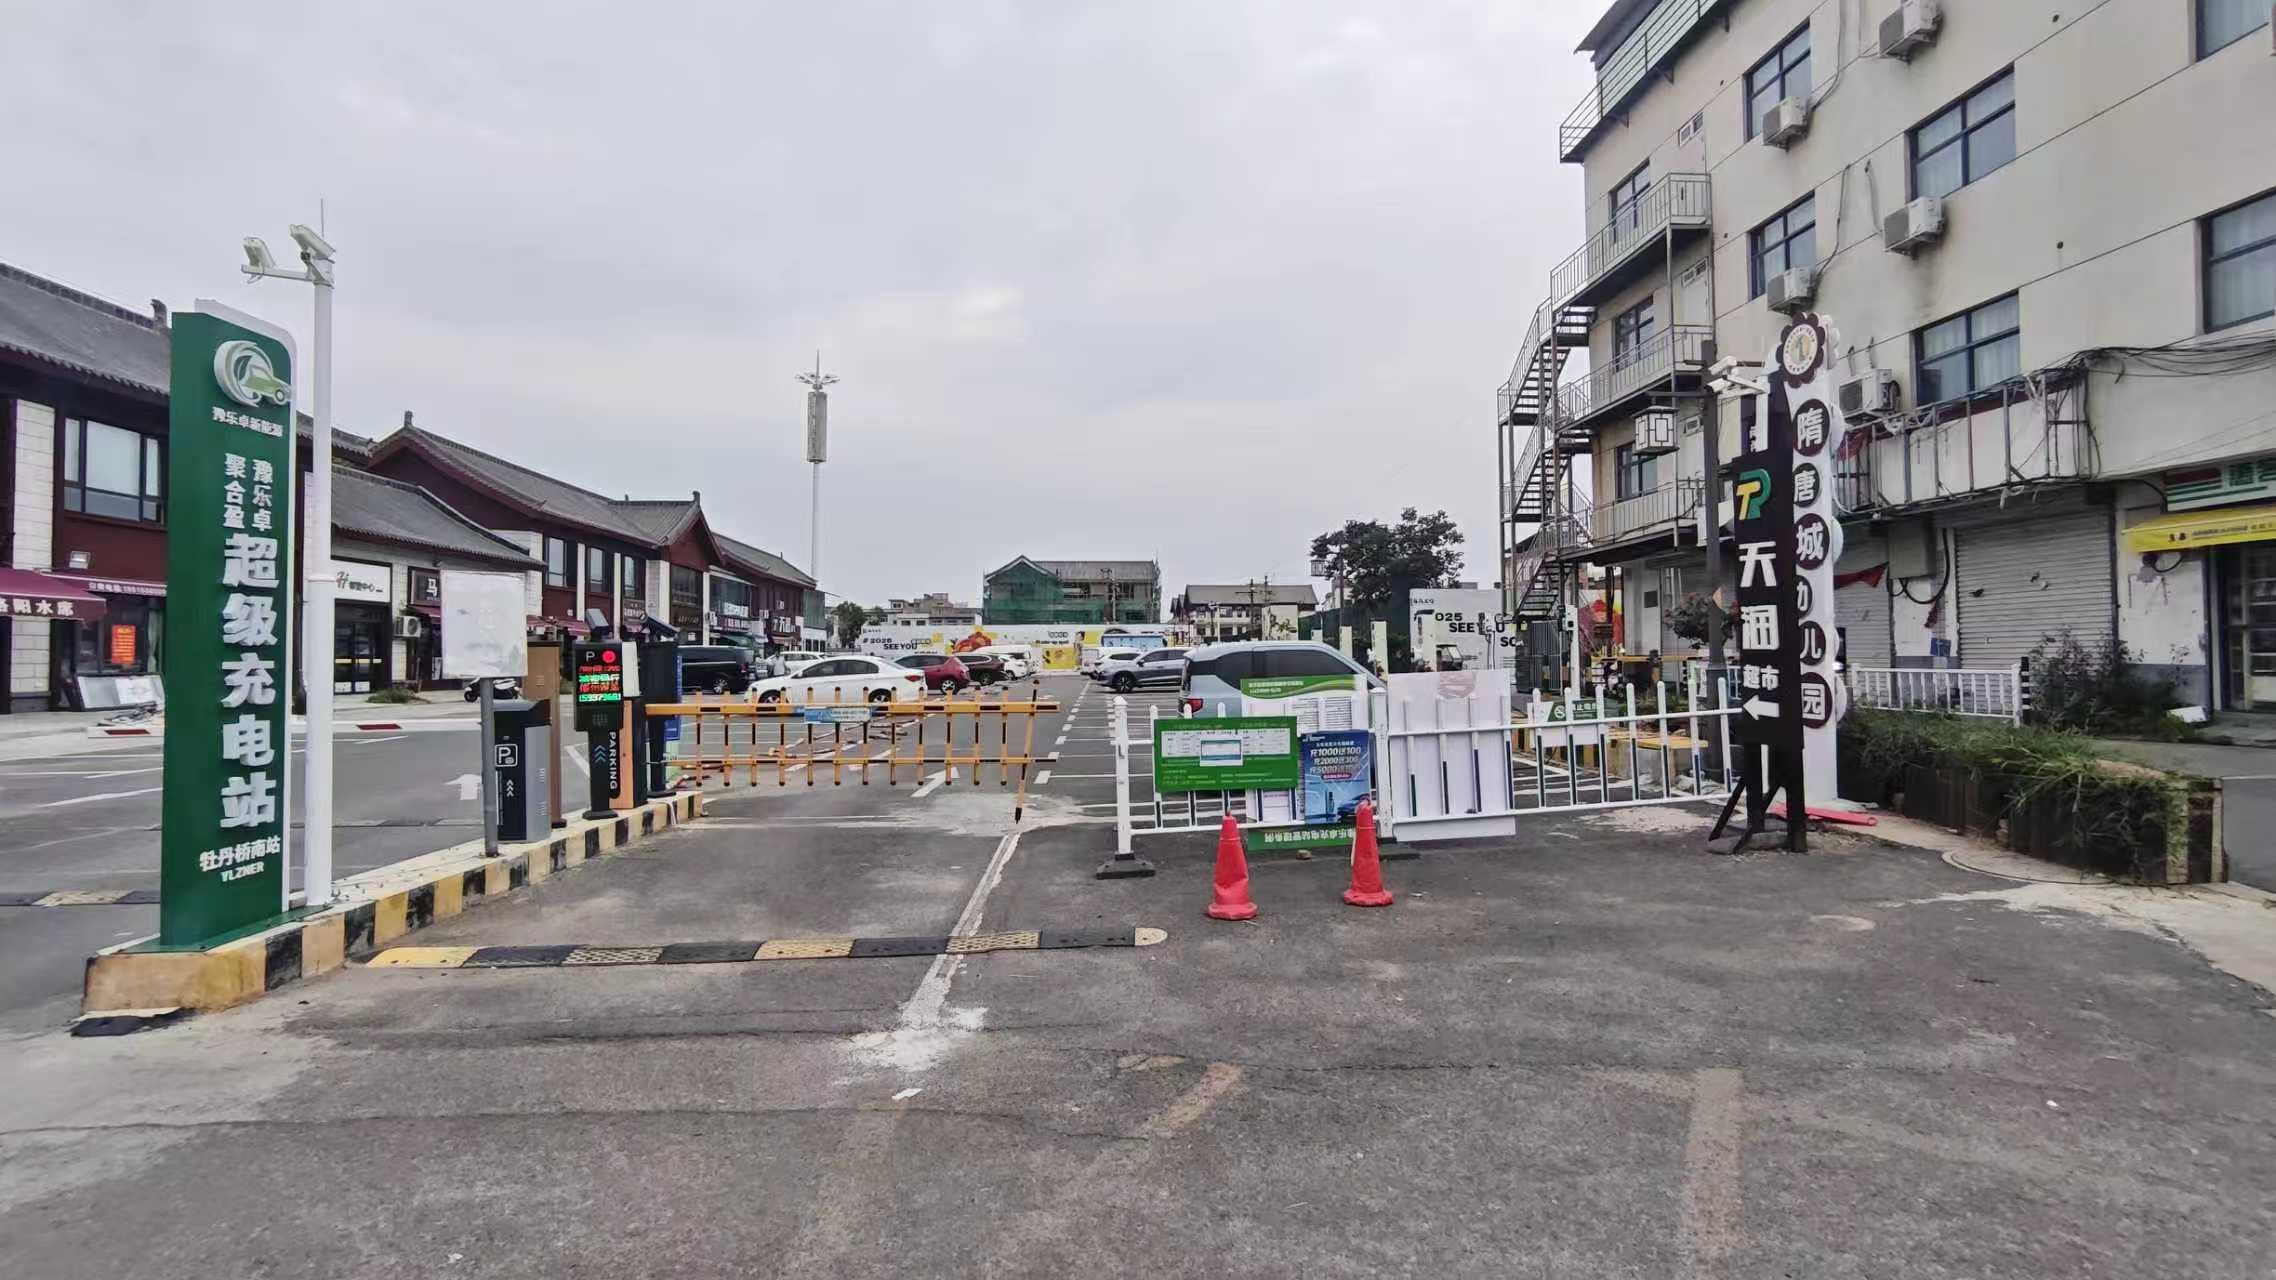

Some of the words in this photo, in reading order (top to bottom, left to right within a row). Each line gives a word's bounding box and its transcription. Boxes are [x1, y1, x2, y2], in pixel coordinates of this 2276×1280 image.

[223, 453, 247, 529] 聚合盈
[252, 458, 273, 531] 豫乐卓
[219, 533, 280, 828] 超级充电站
[1742, 664, 1780, 691] 超市
[608, 731, 619, 790] PARKING
